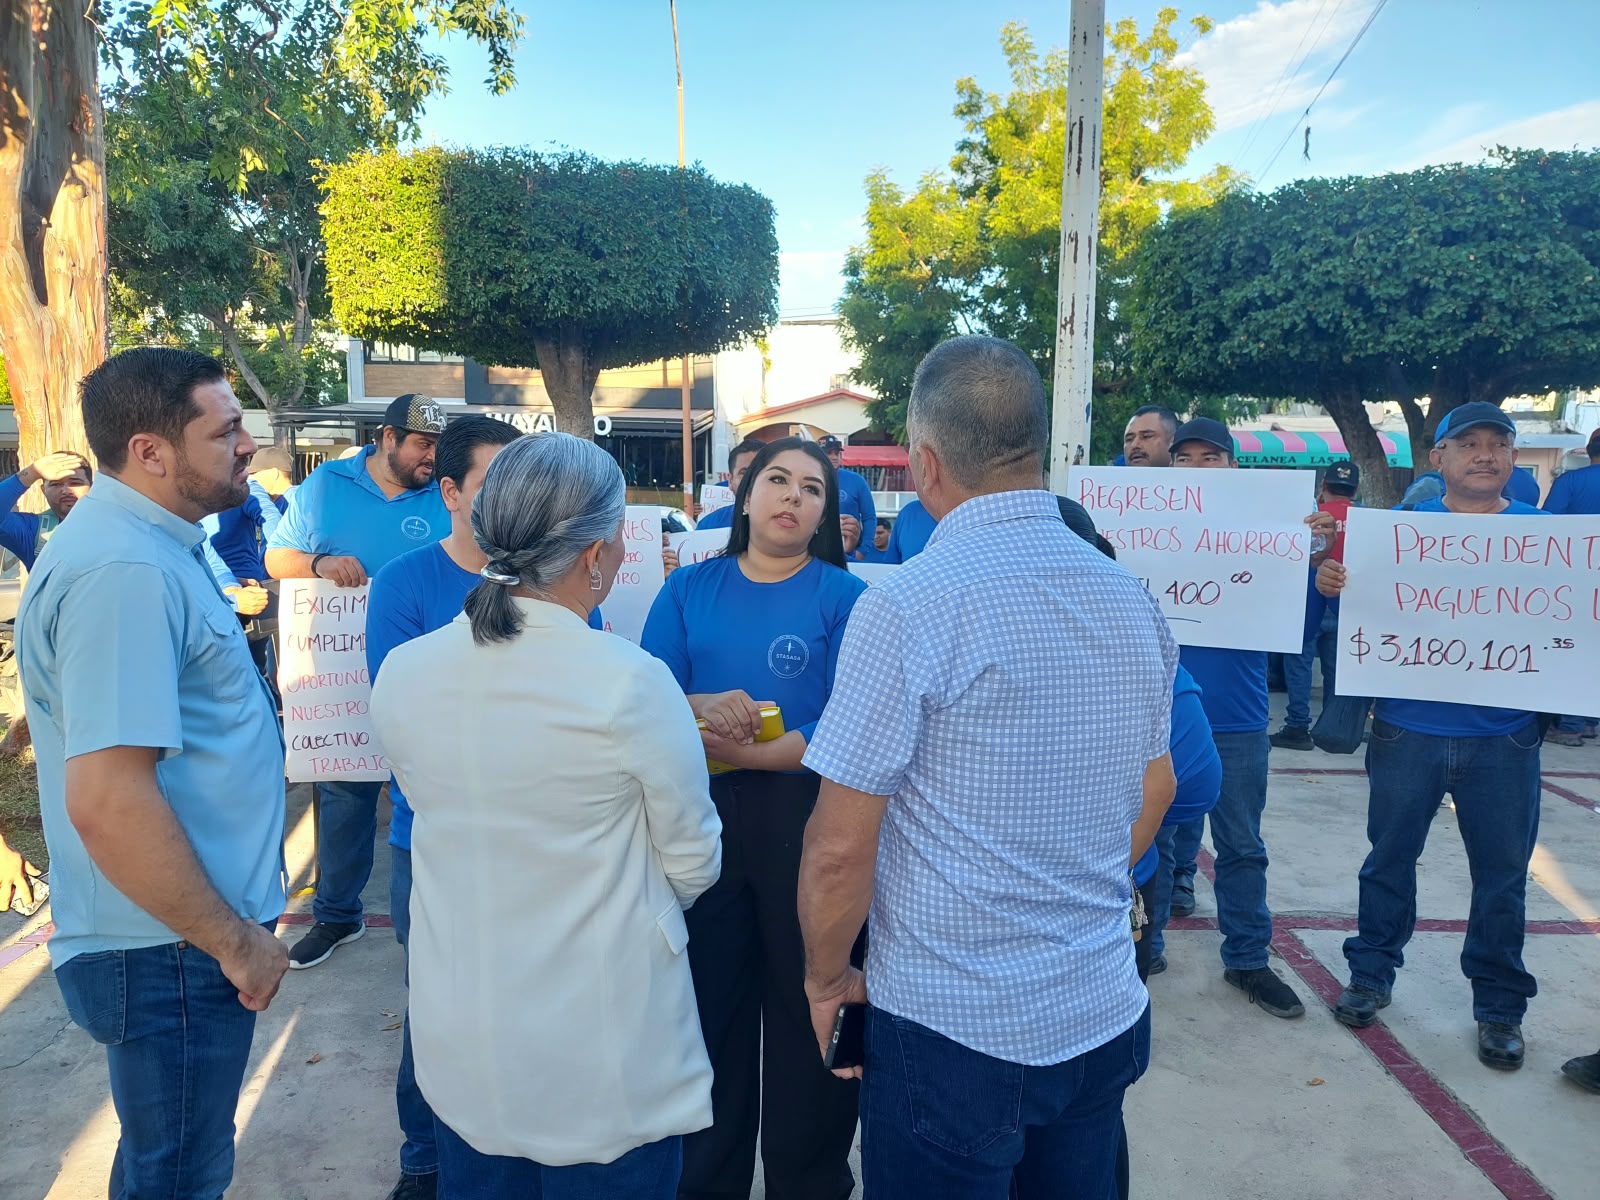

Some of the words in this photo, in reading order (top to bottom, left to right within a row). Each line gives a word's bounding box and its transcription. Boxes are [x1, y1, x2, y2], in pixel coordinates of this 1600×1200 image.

[1237, 455, 1297, 464] CELANEA
[1310, 456, 1334, 464] LAS
[1079, 478, 1203, 517] REGRESEN
[1101, 526, 1183, 552] ESTROS
[1194, 528, 1305, 562] AHORROS
[1393, 523, 1600, 570] PRESIDENT
[293, 588, 367, 622] EXIGIM
[1395, 582, 1573, 620] PAGUENOS
[291, 700, 369, 721] NUESTRO
[292, 731, 370, 751] COLECTIVO
